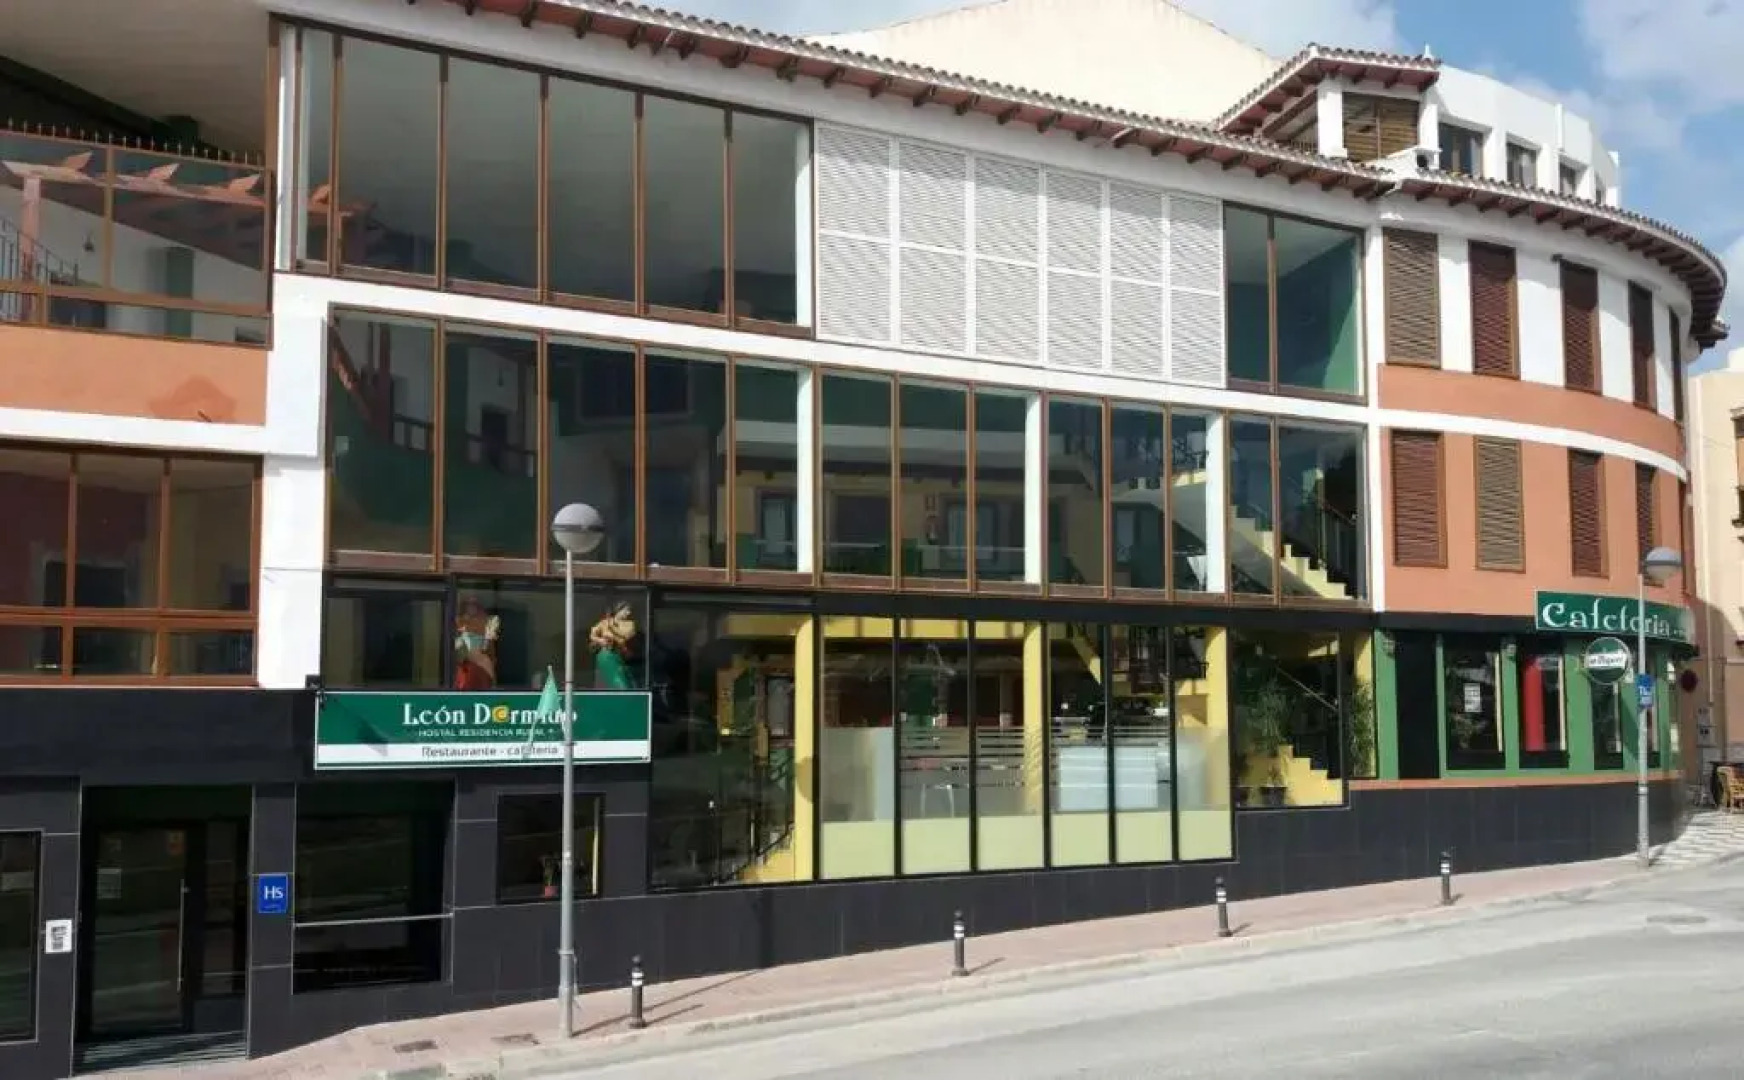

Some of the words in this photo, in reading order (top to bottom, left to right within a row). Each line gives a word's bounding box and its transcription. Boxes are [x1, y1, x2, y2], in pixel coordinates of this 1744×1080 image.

[418, 728, 456, 737] HOSTAL
[459, 728, 513, 737] RESIDENCIA
[422, 746, 497, 757] Restaurante
